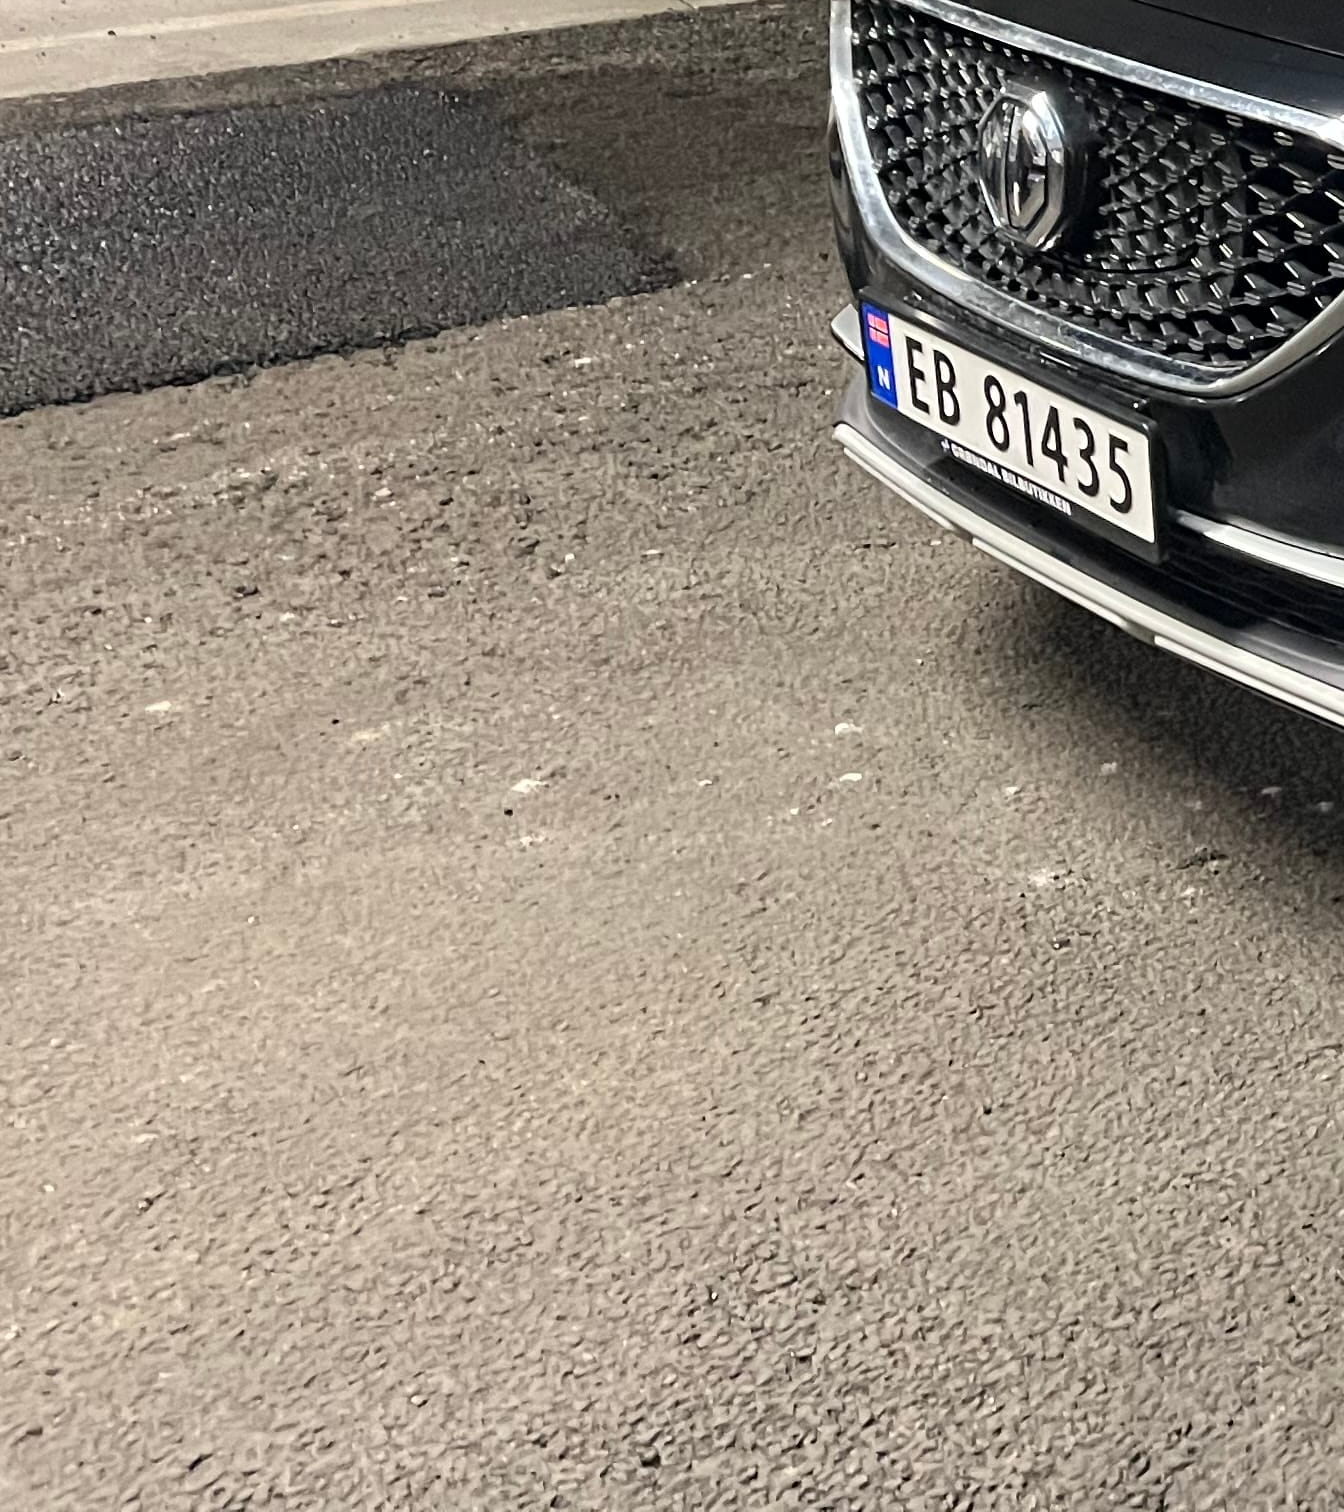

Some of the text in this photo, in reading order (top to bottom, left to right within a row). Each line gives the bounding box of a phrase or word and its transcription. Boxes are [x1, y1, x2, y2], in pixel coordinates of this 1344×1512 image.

[877, 365, 891, 390] N
[905, 336, 1133, 514] EB 81435
